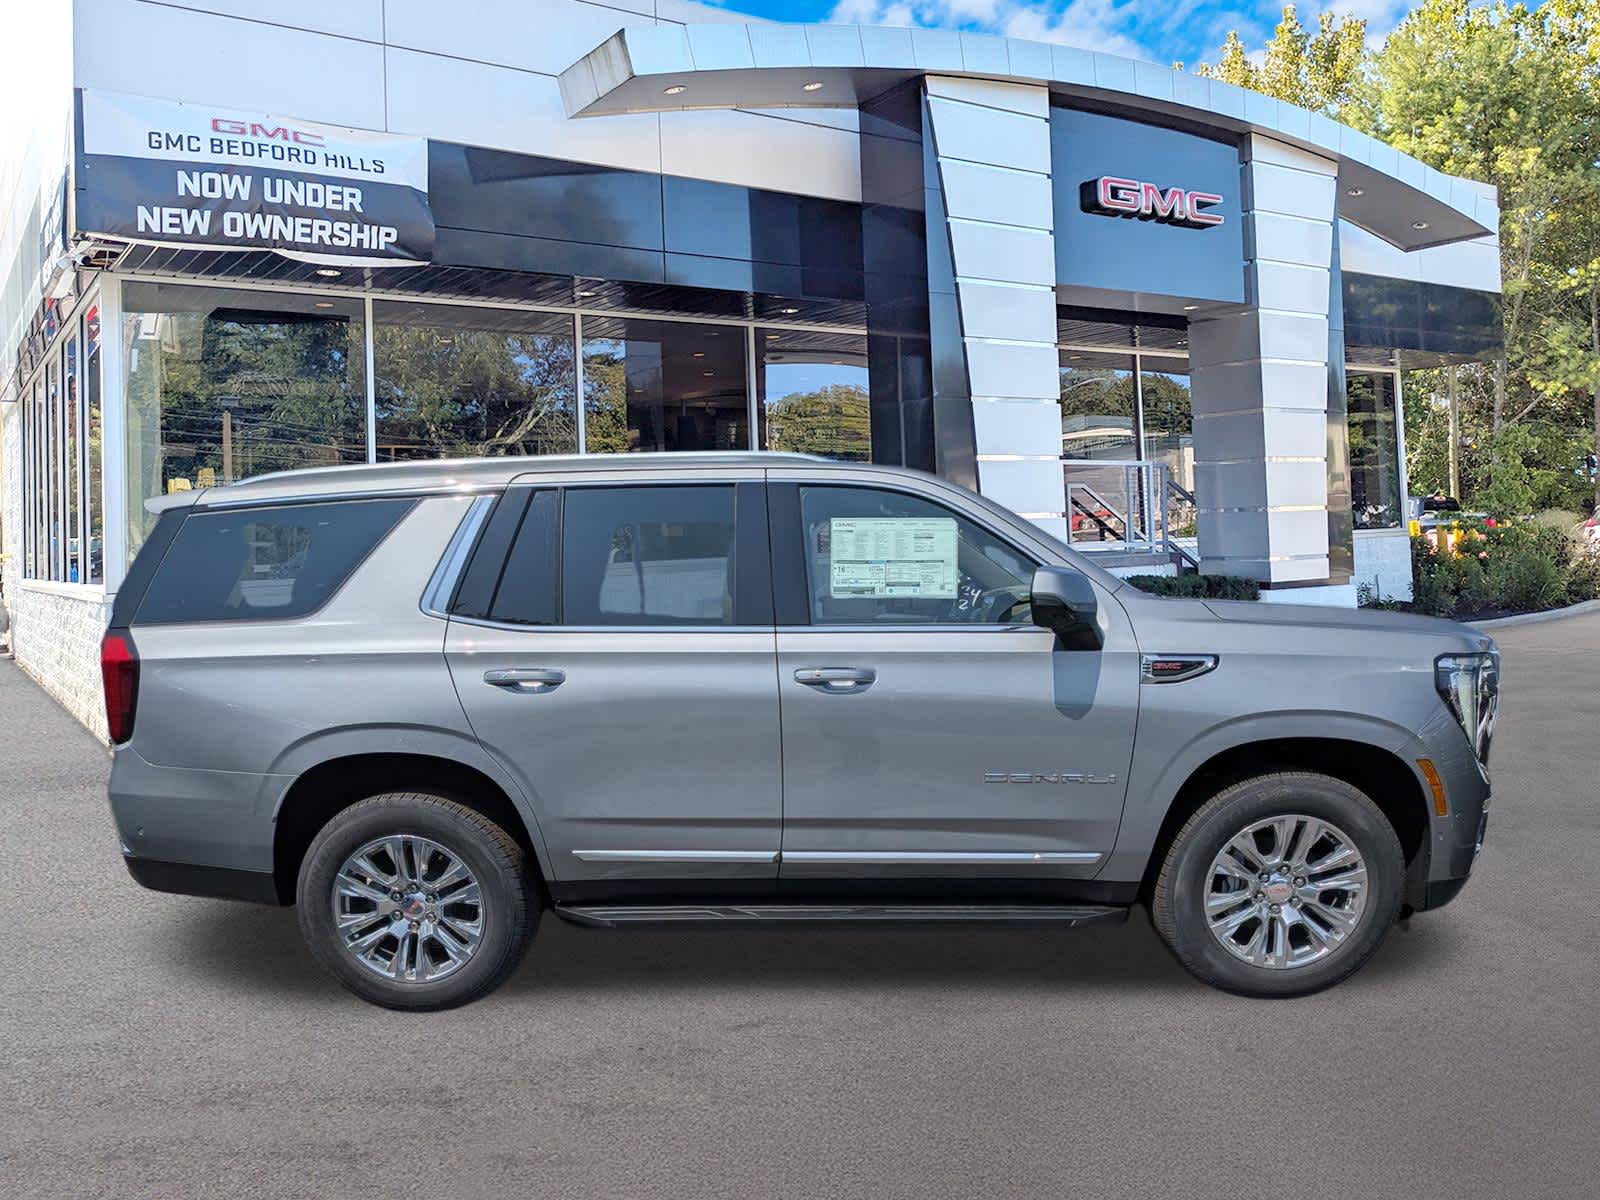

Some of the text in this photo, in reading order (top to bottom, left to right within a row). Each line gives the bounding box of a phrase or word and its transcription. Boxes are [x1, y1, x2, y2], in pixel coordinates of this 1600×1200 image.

[148, 131, 386, 174] GMC BEDFORD HILLS
[212, 118, 326, 147] GMC
[177, 170, 364, 213] NOW UNDER
[1097, 175, 1225, 225] GMC
[137, 206, 398, 250] NEW OWNERSHIP
[1152, 662, 1182, 670] GMC
[984, 772, 1117, 784] DENALI
